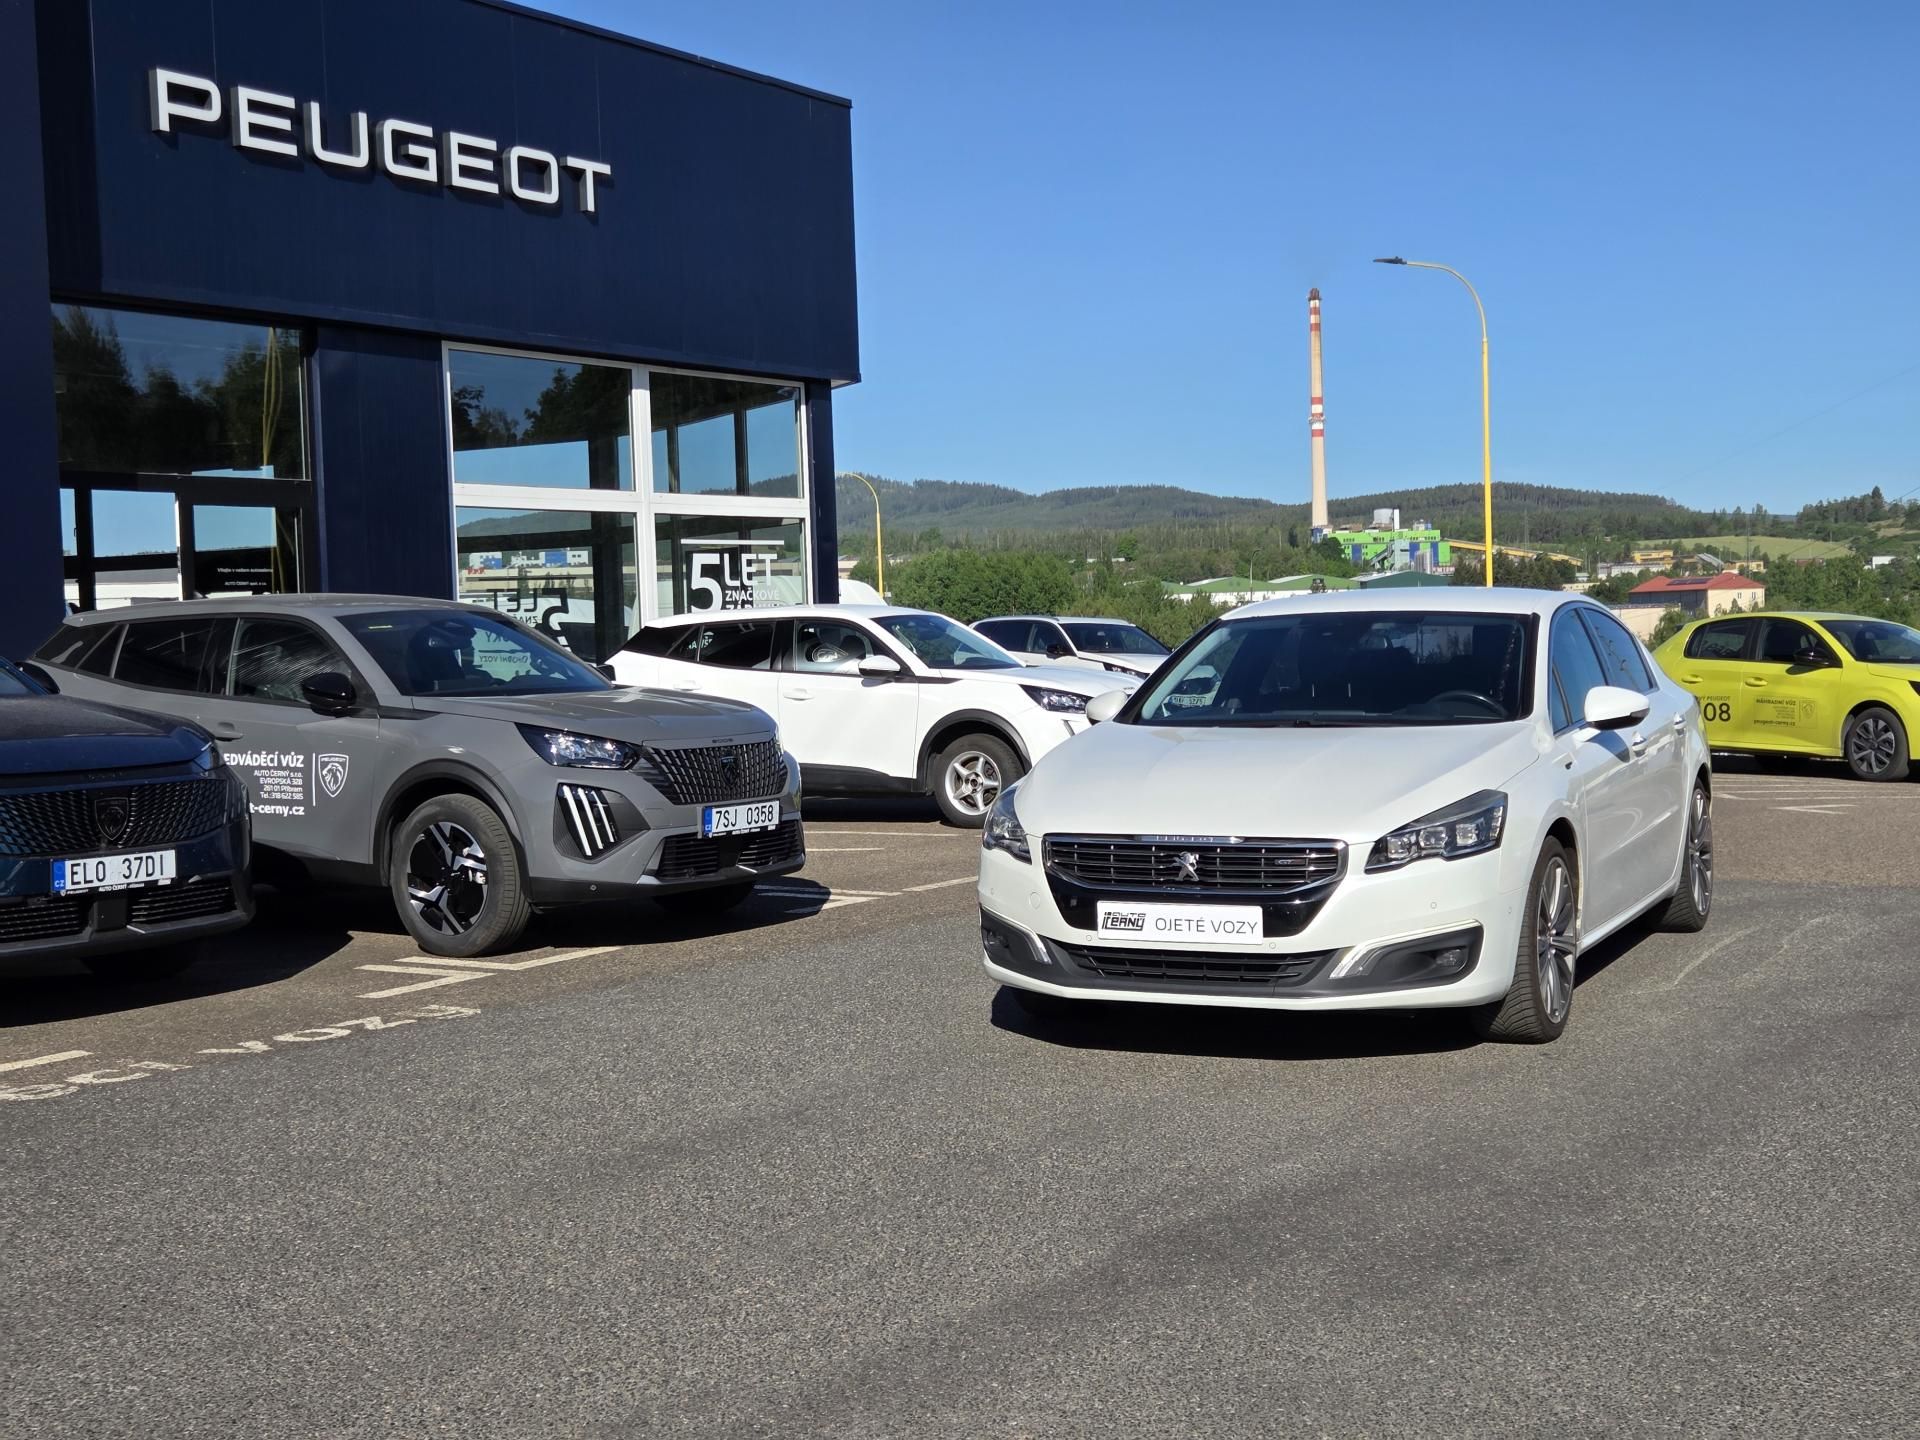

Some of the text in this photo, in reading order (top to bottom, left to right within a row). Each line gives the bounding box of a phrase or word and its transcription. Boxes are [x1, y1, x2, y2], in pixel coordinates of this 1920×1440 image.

[149, 67, 611, 213] PEUGEOT
[691, 553, 777, 613] 5 LET
[1703, 702, 1731, 722] 08
[223, 751, 304, 768] EDVÁDĚCÍ VŮZ
[253, 769, 269, 777] AUTO
[270, 768, 290, 777] ČERNÝ
[259, 776, 291, 785] EVROPSKÁ
[249, 802, 305, 817] t-cerny.cz
[715, 808, 738, 830] 7SJ
[746, 804, 774, 825] 0358
[54, 880, 65, 888] CZ
[122, 854, 164, 880] 37DI
[1155, 917, 1258, 935] OJETÉ VOZY
